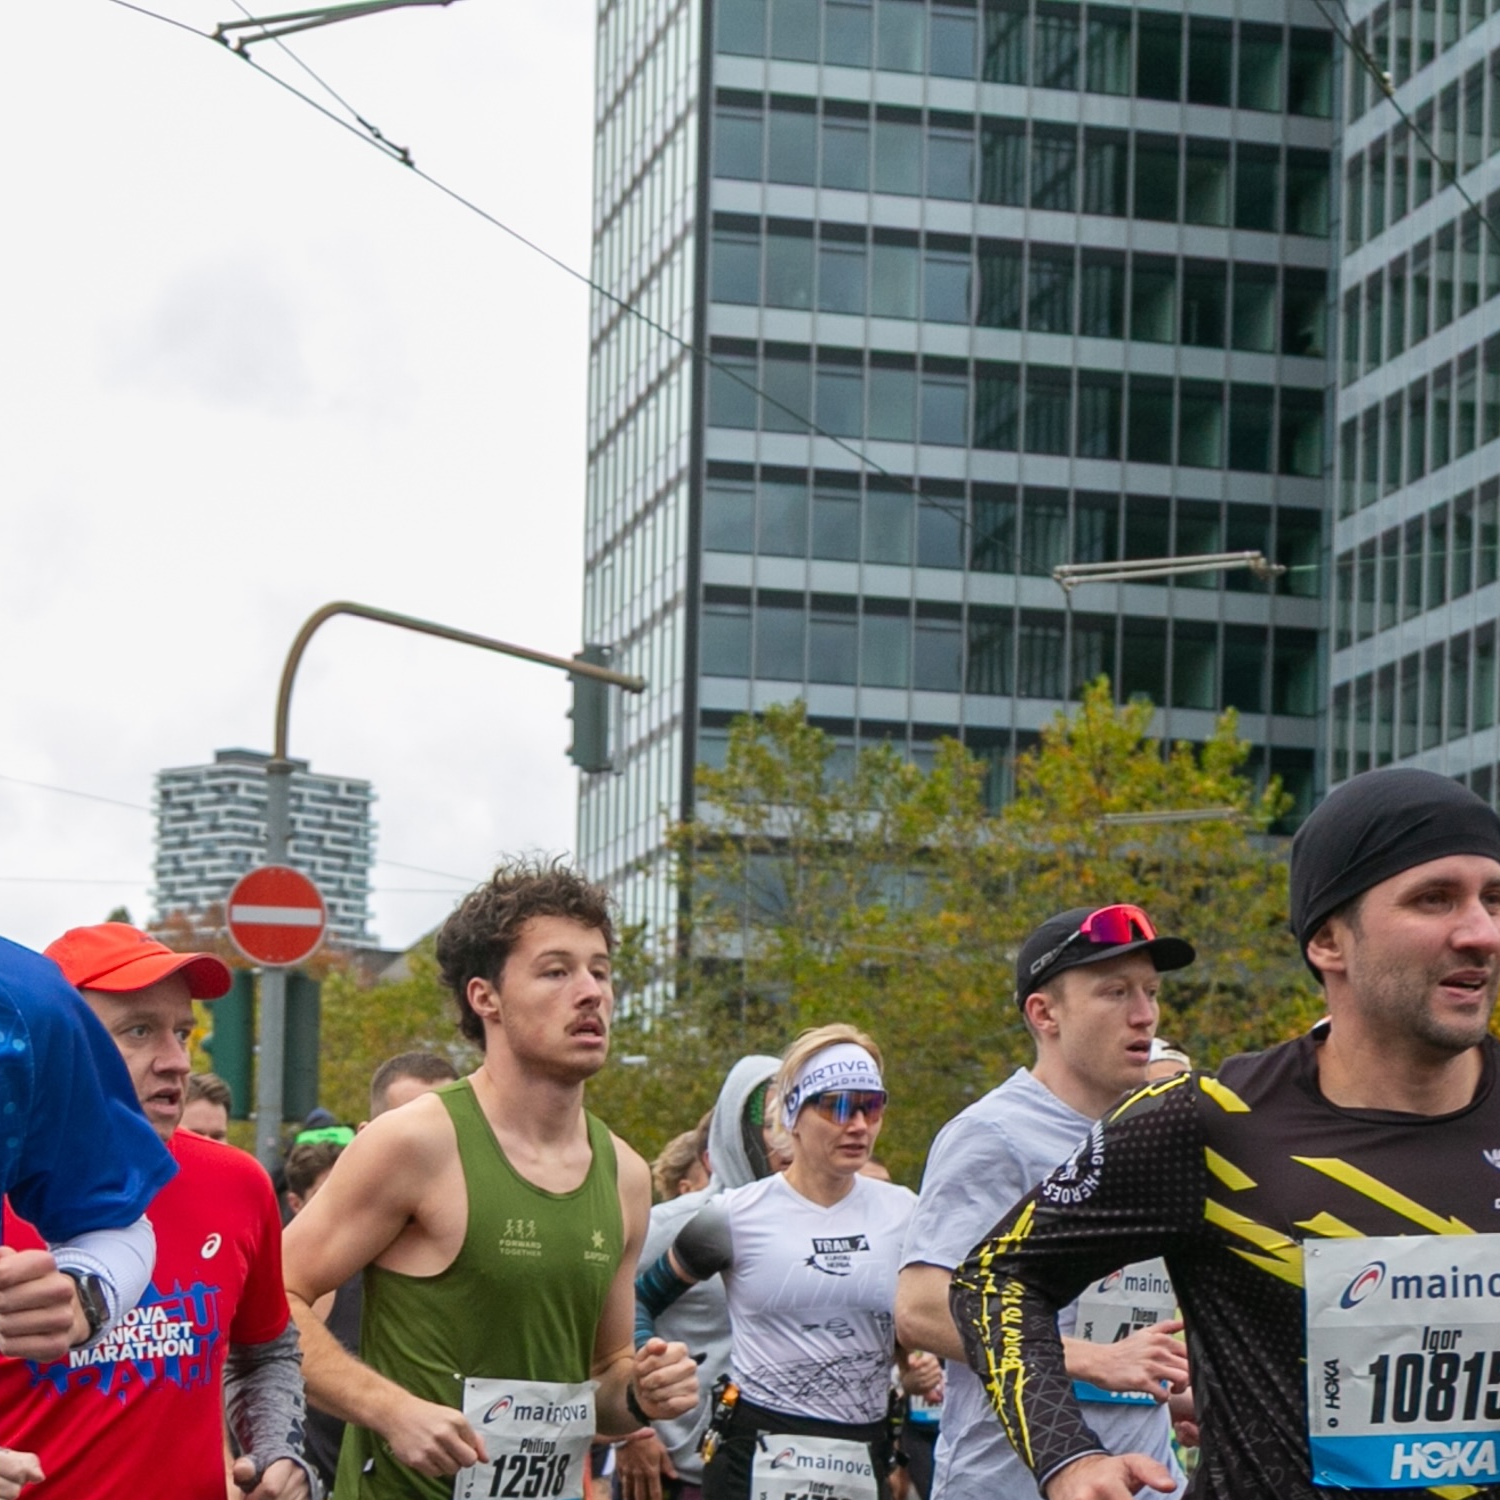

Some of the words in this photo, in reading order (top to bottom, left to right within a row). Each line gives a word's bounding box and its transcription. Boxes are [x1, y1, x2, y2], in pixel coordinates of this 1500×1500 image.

[1124, 1273, 1173, 1294] maino
[69, 1338, 194, 1368] MARATHON
[1000, 1326, 1024, 1370] BORN
[1421, 1326, 1462, 1355] Igor
[1324, 1358, 1341, 1411] HOKA
[513, 1402, 588, 1422] mainova
[519, 1438, 556, 1457] Philipp
[1390, 1439, 1498, 1481] HOKA
[489, 1453, 572, 1498] 12518
[796, 1454, 872, 1477] mainova
[808, 1480, 834, 1496] Indre
